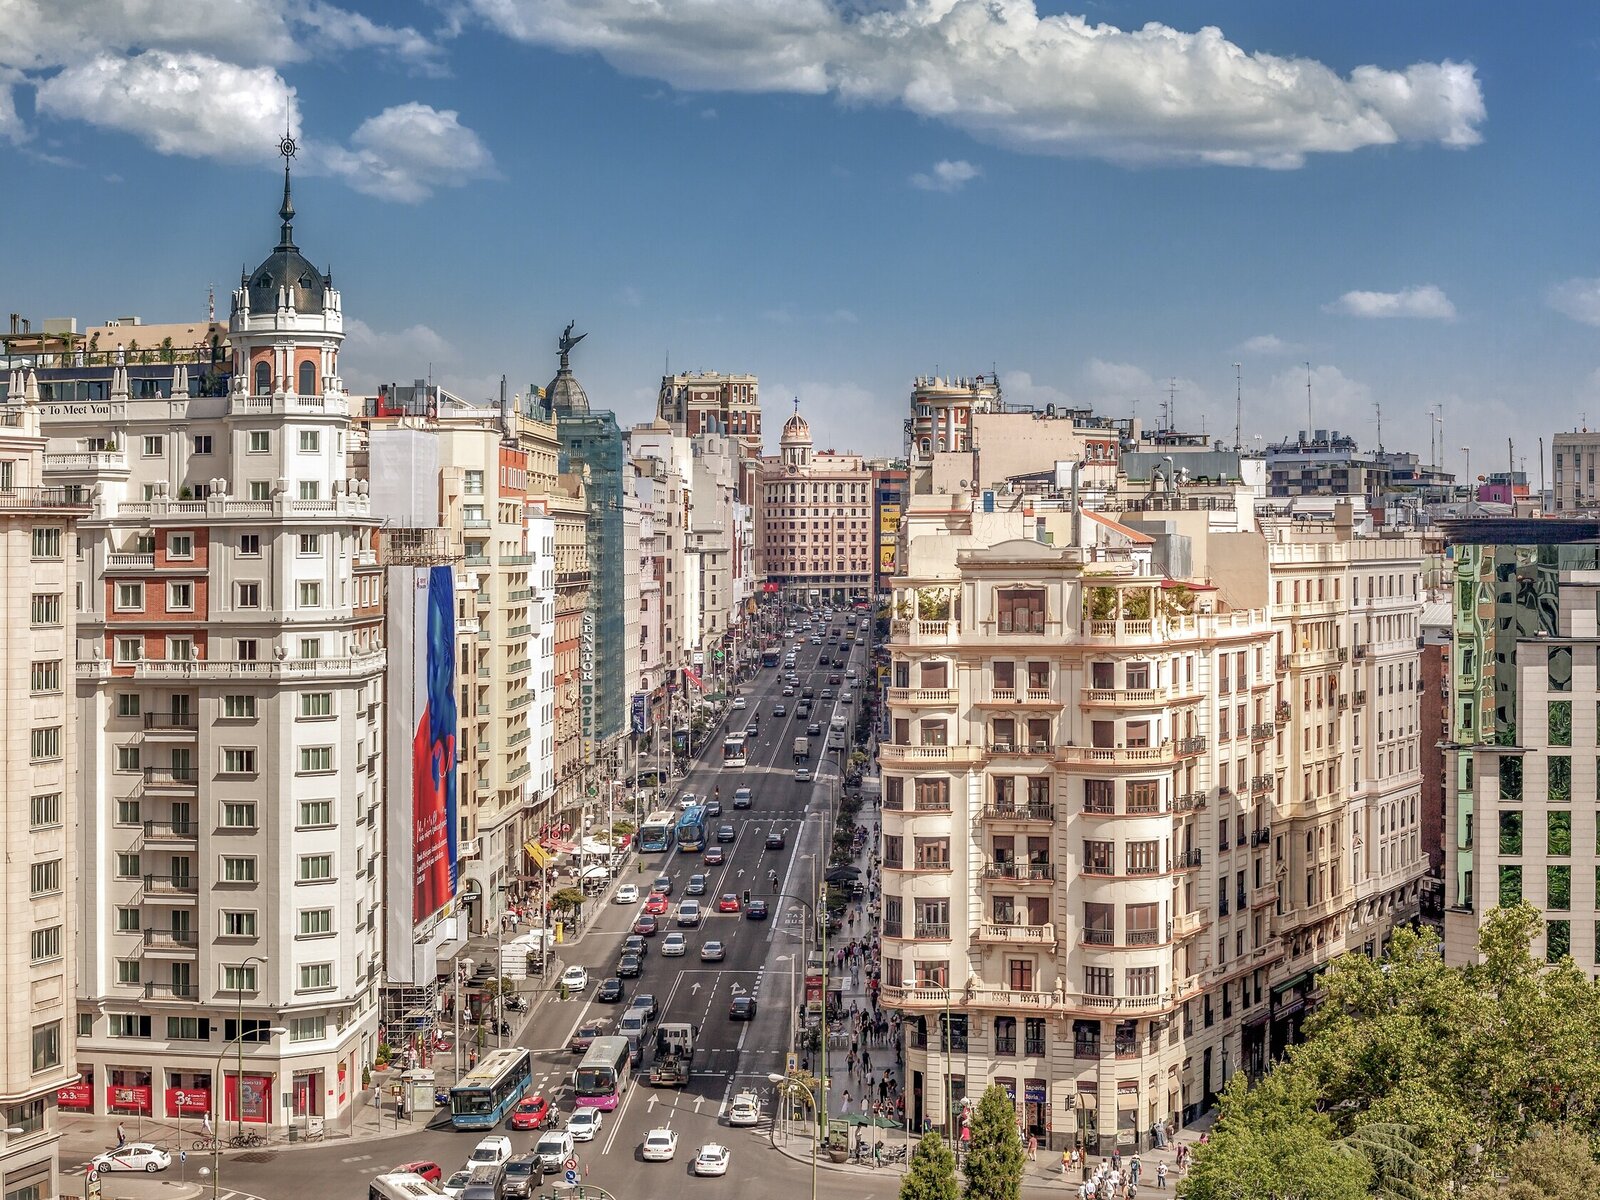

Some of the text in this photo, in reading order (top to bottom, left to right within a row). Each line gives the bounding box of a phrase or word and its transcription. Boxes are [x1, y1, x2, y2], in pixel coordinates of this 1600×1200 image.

[48, 405, 61, 415] To
[63, 405, 87, 414] Meet
[90, 404, 109, 414] You
[582, 615, 594, 681] SENATOR
[582, 685, 593, 738] HOTEL
[174, 1091, 193, 1105] 3%
[741, 1087, 775, 1095] TAXI
